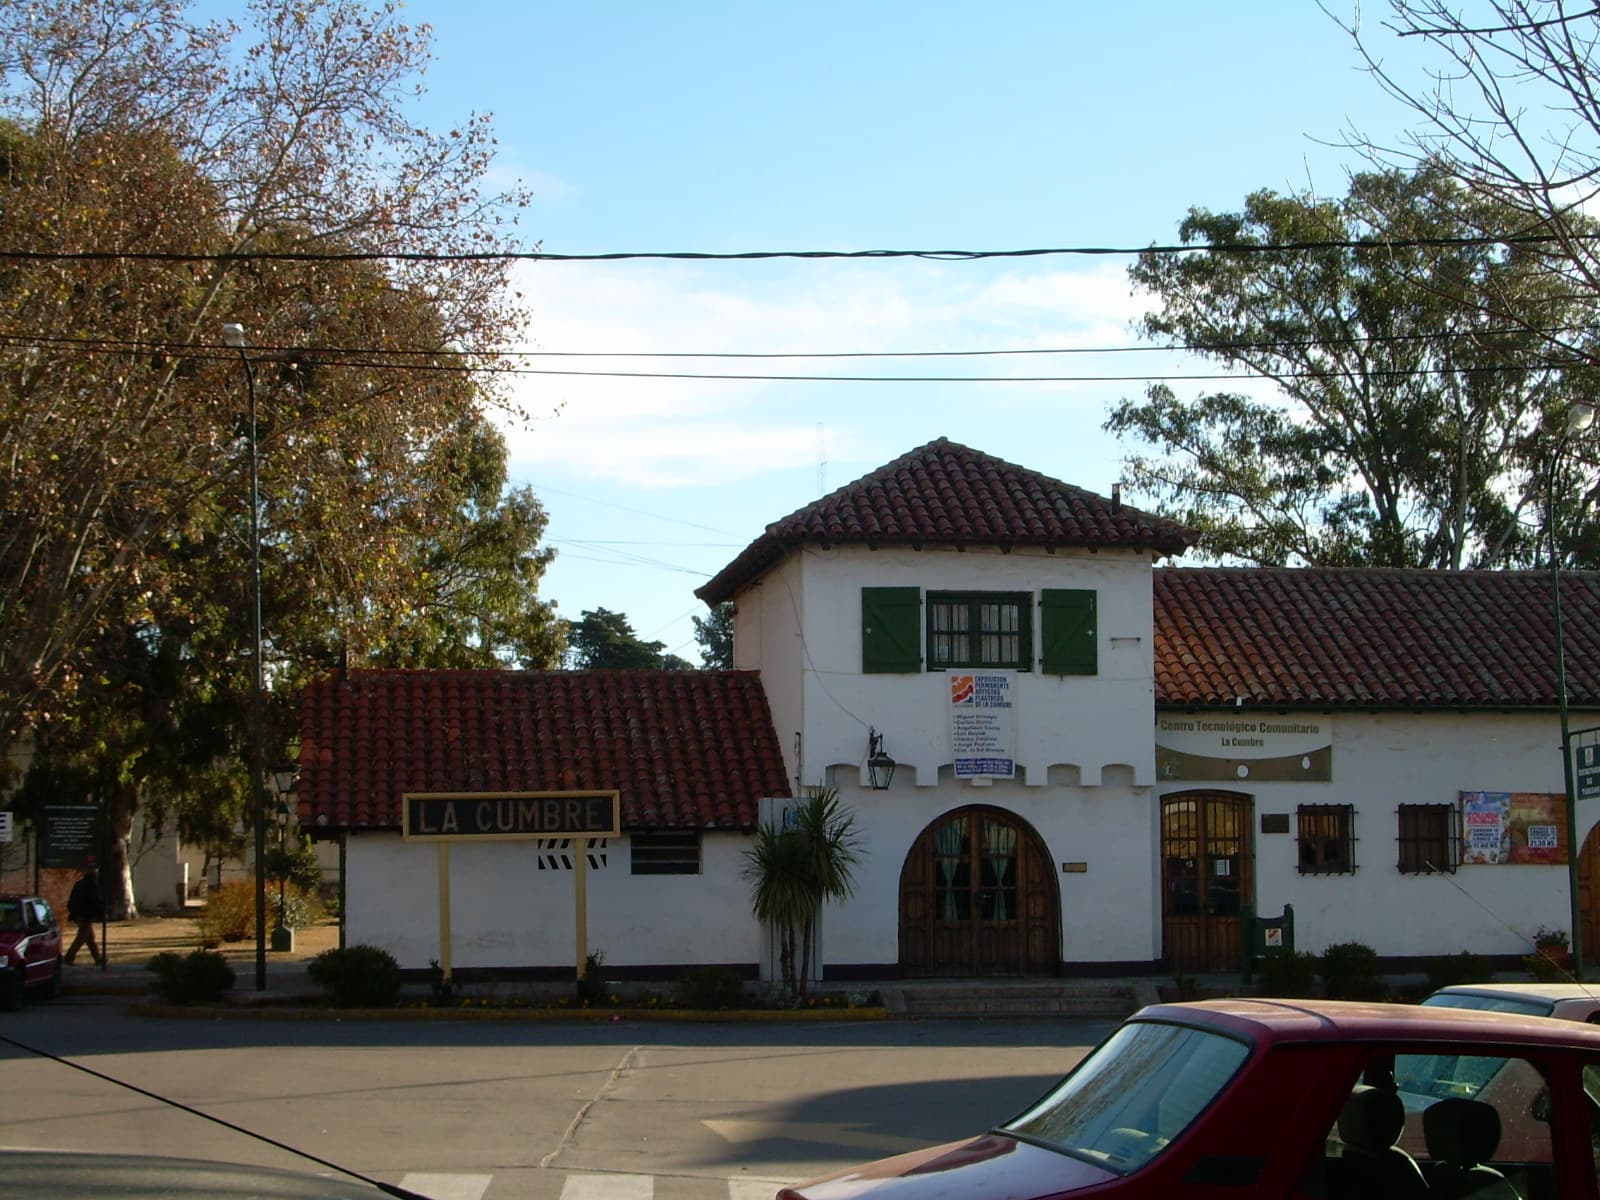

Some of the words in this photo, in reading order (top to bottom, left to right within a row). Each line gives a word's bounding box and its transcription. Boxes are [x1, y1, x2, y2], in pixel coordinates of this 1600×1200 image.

[1160, 719, 1194, 731] Centro
[1196, 720, 1257, 734] Tecnológico
[1260, 722, 1320, 735] Comunitario
[1221, 737, 1231, 747] La
[1232, 737, 1265, 747] Cumbre
[419, 801, 459, 833] LA
[476, 798, 604, 831] CUMBRE
